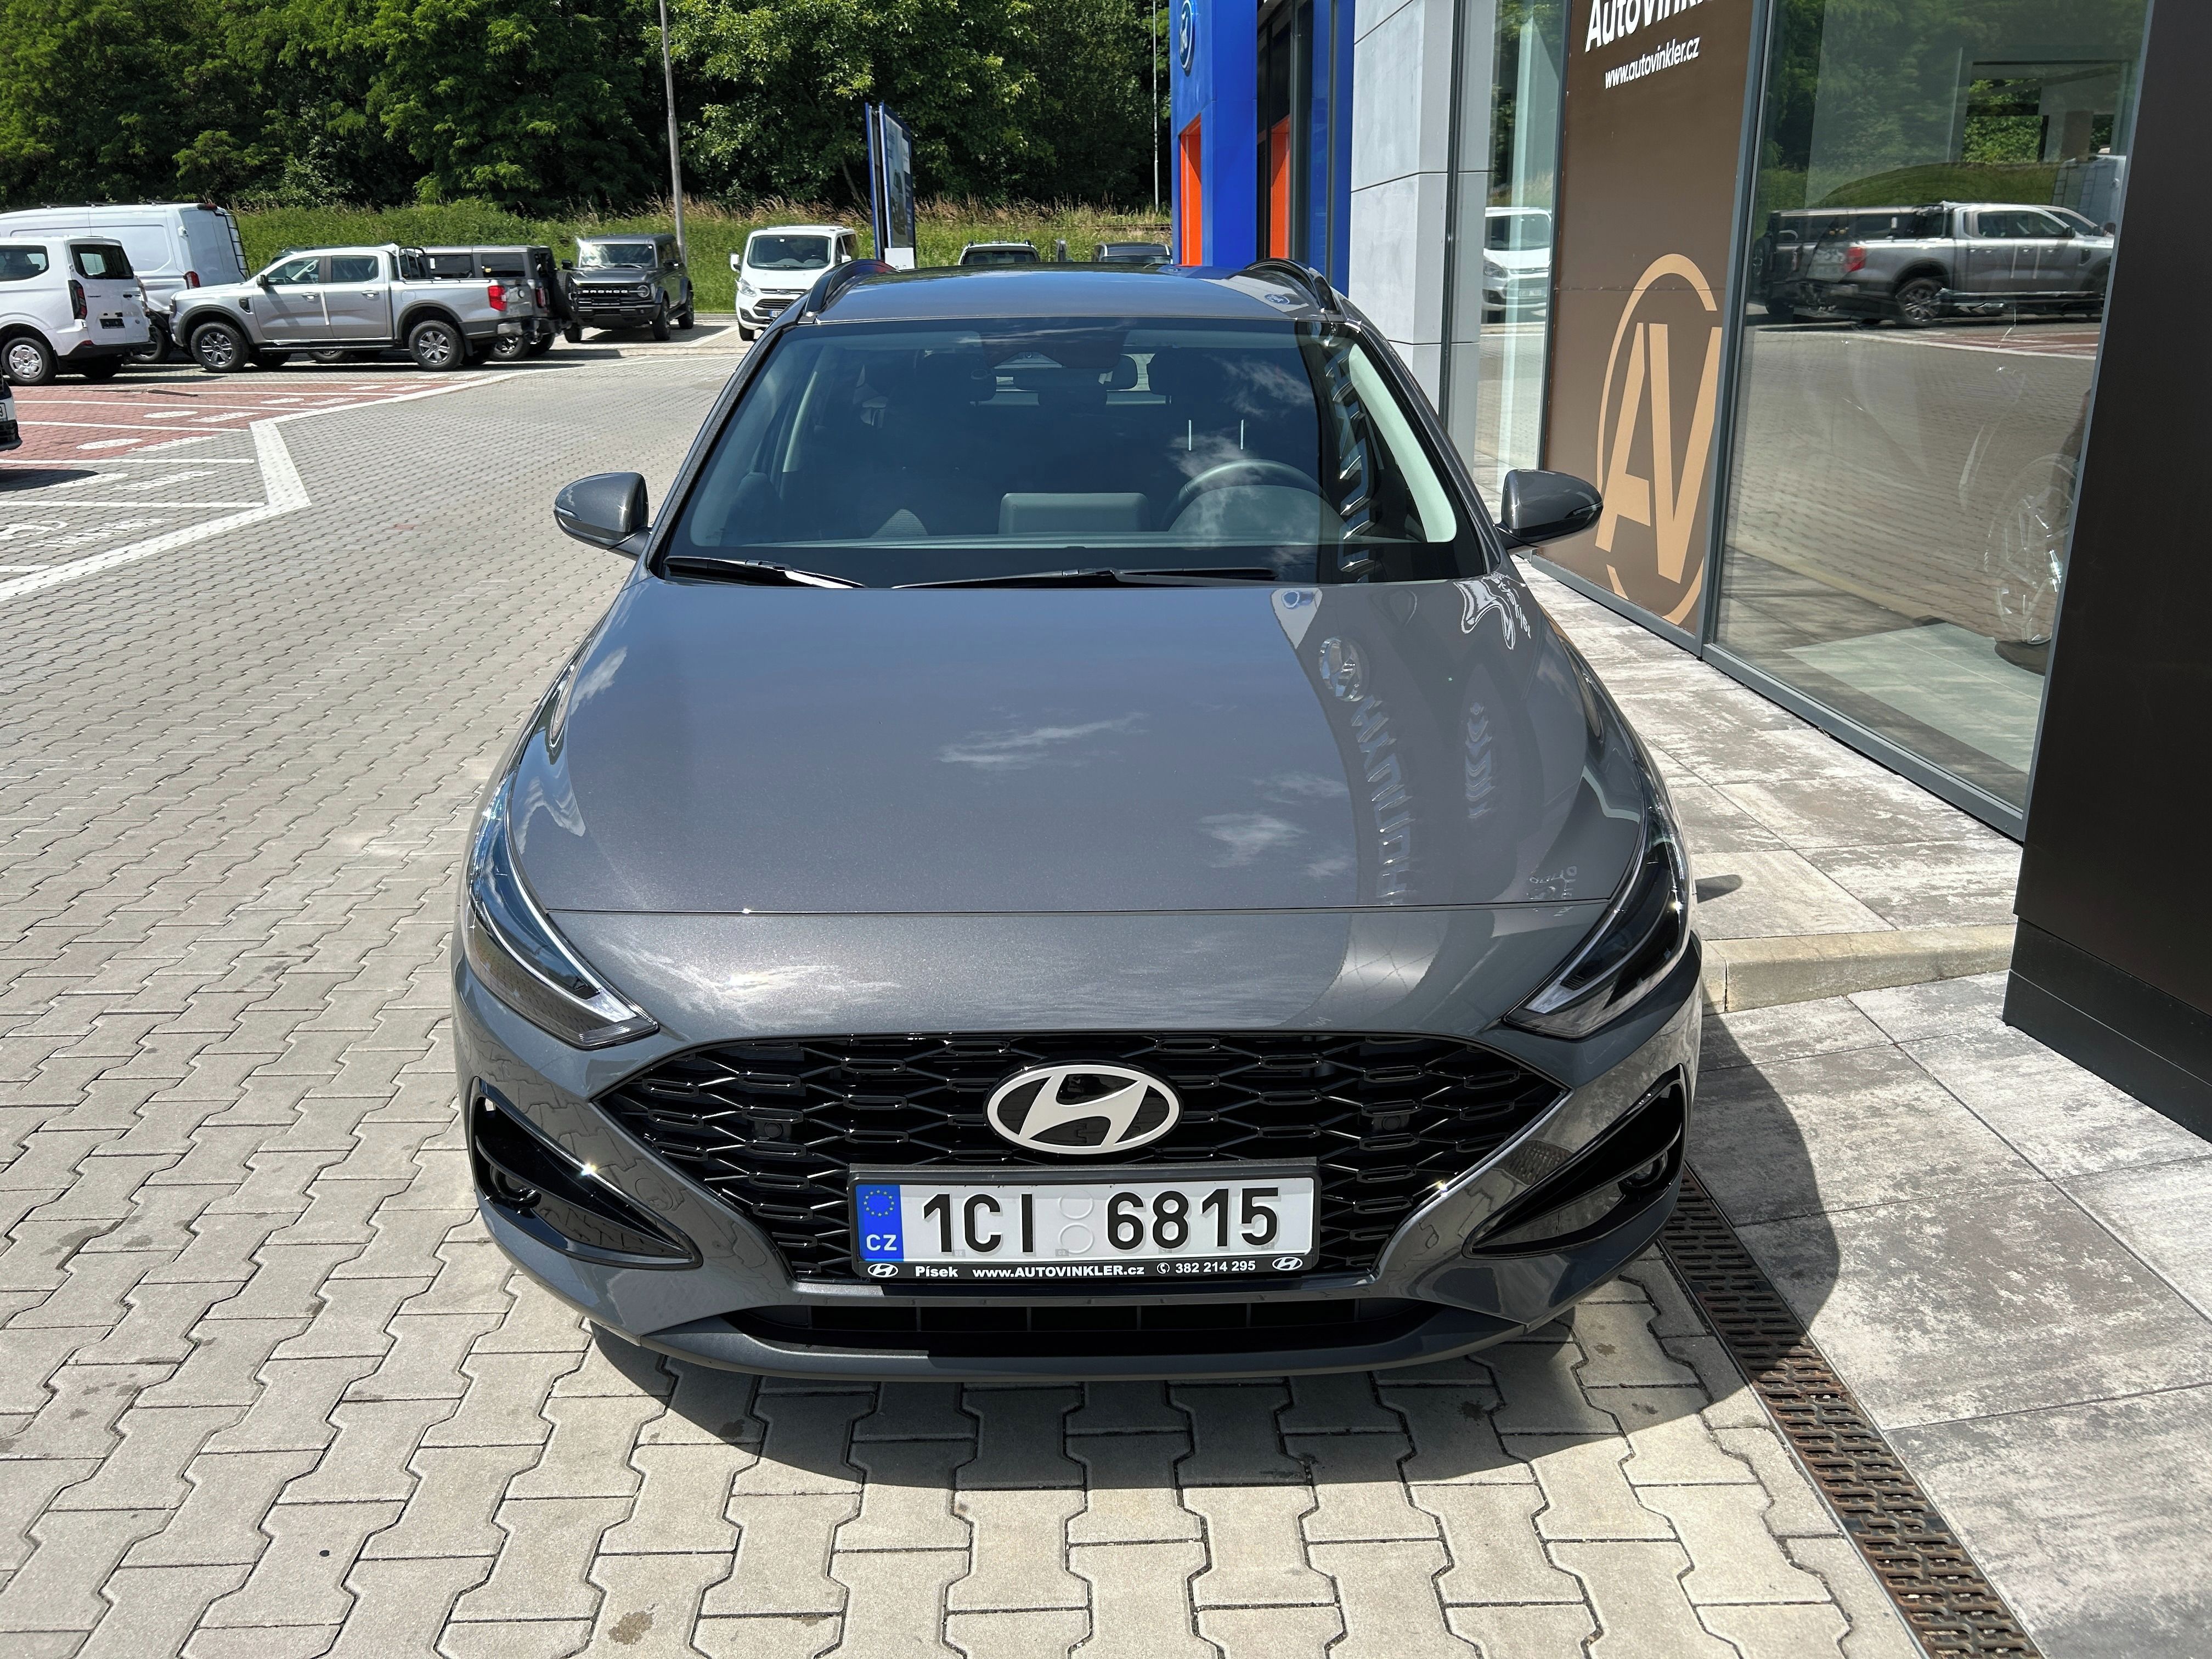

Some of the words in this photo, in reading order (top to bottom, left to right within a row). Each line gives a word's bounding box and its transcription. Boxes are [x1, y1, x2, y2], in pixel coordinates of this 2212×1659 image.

[1605, 37, 1700, 89] www.autovinkler.cz
[923, 1193, 1034, 1252] 1CI
[1107, 1187, 1279, 1250] 6815
[866, 1234, 898, 1251] CZ
[915, 1266, 958, 1278] Písek
[972, 1265, 1145, 1278] www.AUTOVINKLER.cz
[1175, 1263, 1200, 1274] 382
[1203, 1262, 1228, 1273] 214
[1231, 1260, 1256, 1272] 295
